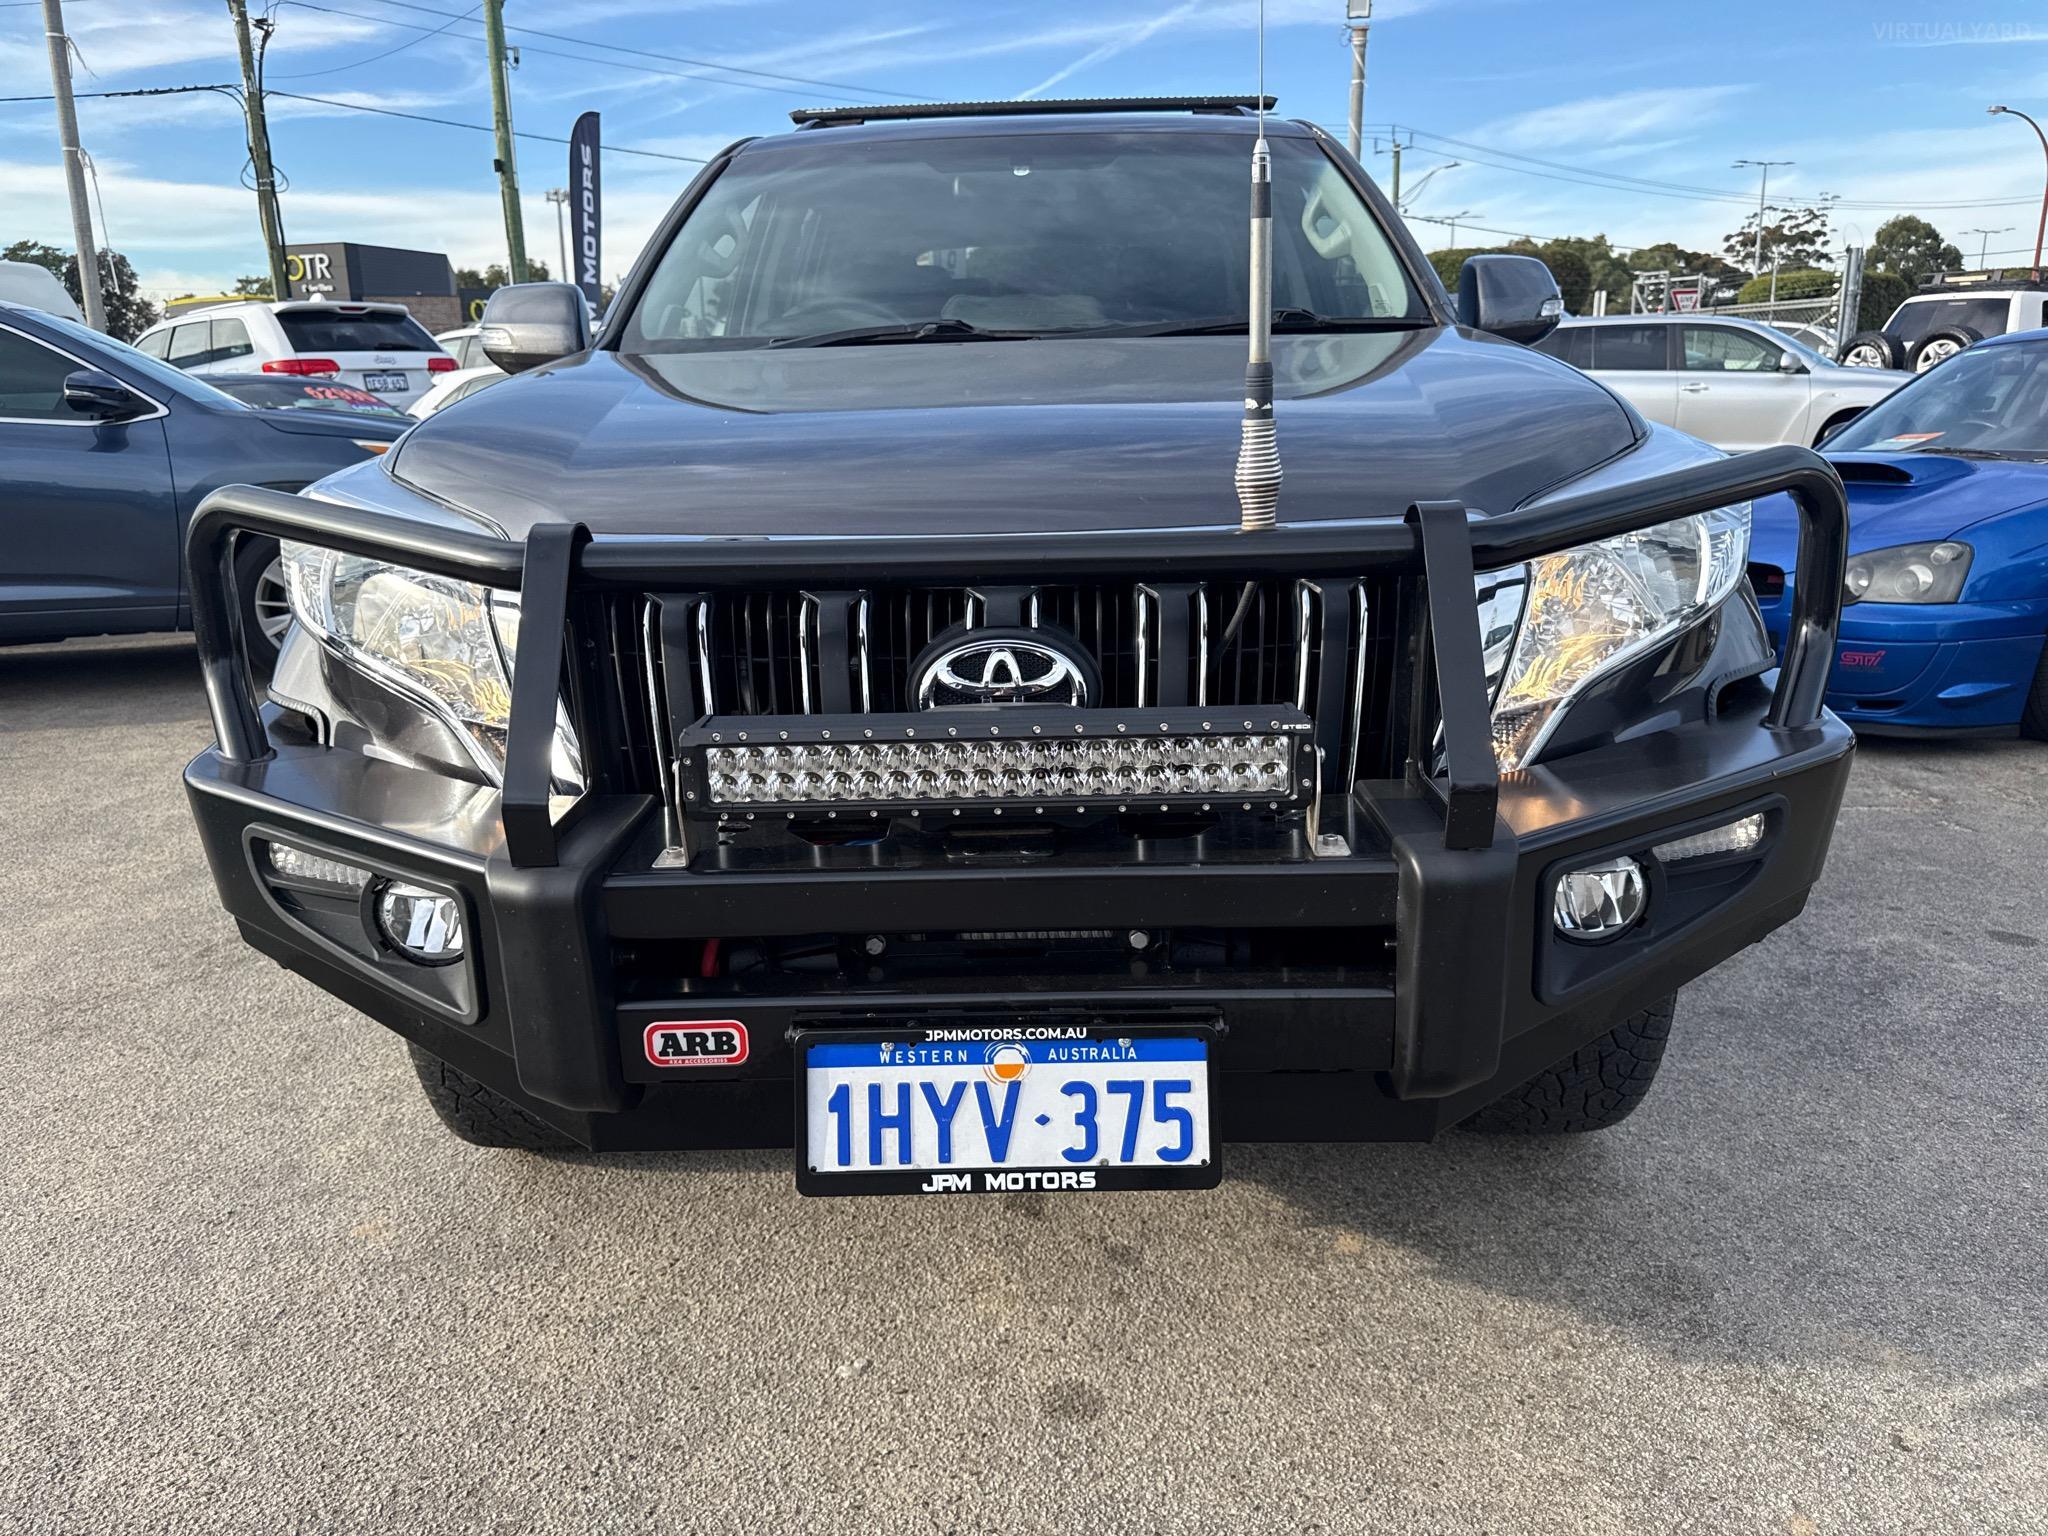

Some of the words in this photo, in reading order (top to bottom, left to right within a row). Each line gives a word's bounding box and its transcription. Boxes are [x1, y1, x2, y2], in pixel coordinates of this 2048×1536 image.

[580, 143, 597, 284] MOTORS
[925, 1027, 1087, 1042] JPMMOTORS.COM.AU
[658, 1031, 738, 1058] ARB
[684, 1057, 729, 1065] ACCESSORIES
[879, 1050, 968, 1064] WESTERN
[1047, 1047, 1138, 1061] AUSTRALIA
[921, 1173, 972, 1192] JPM
[985, 1171, 1097, 1190] MOTORS
